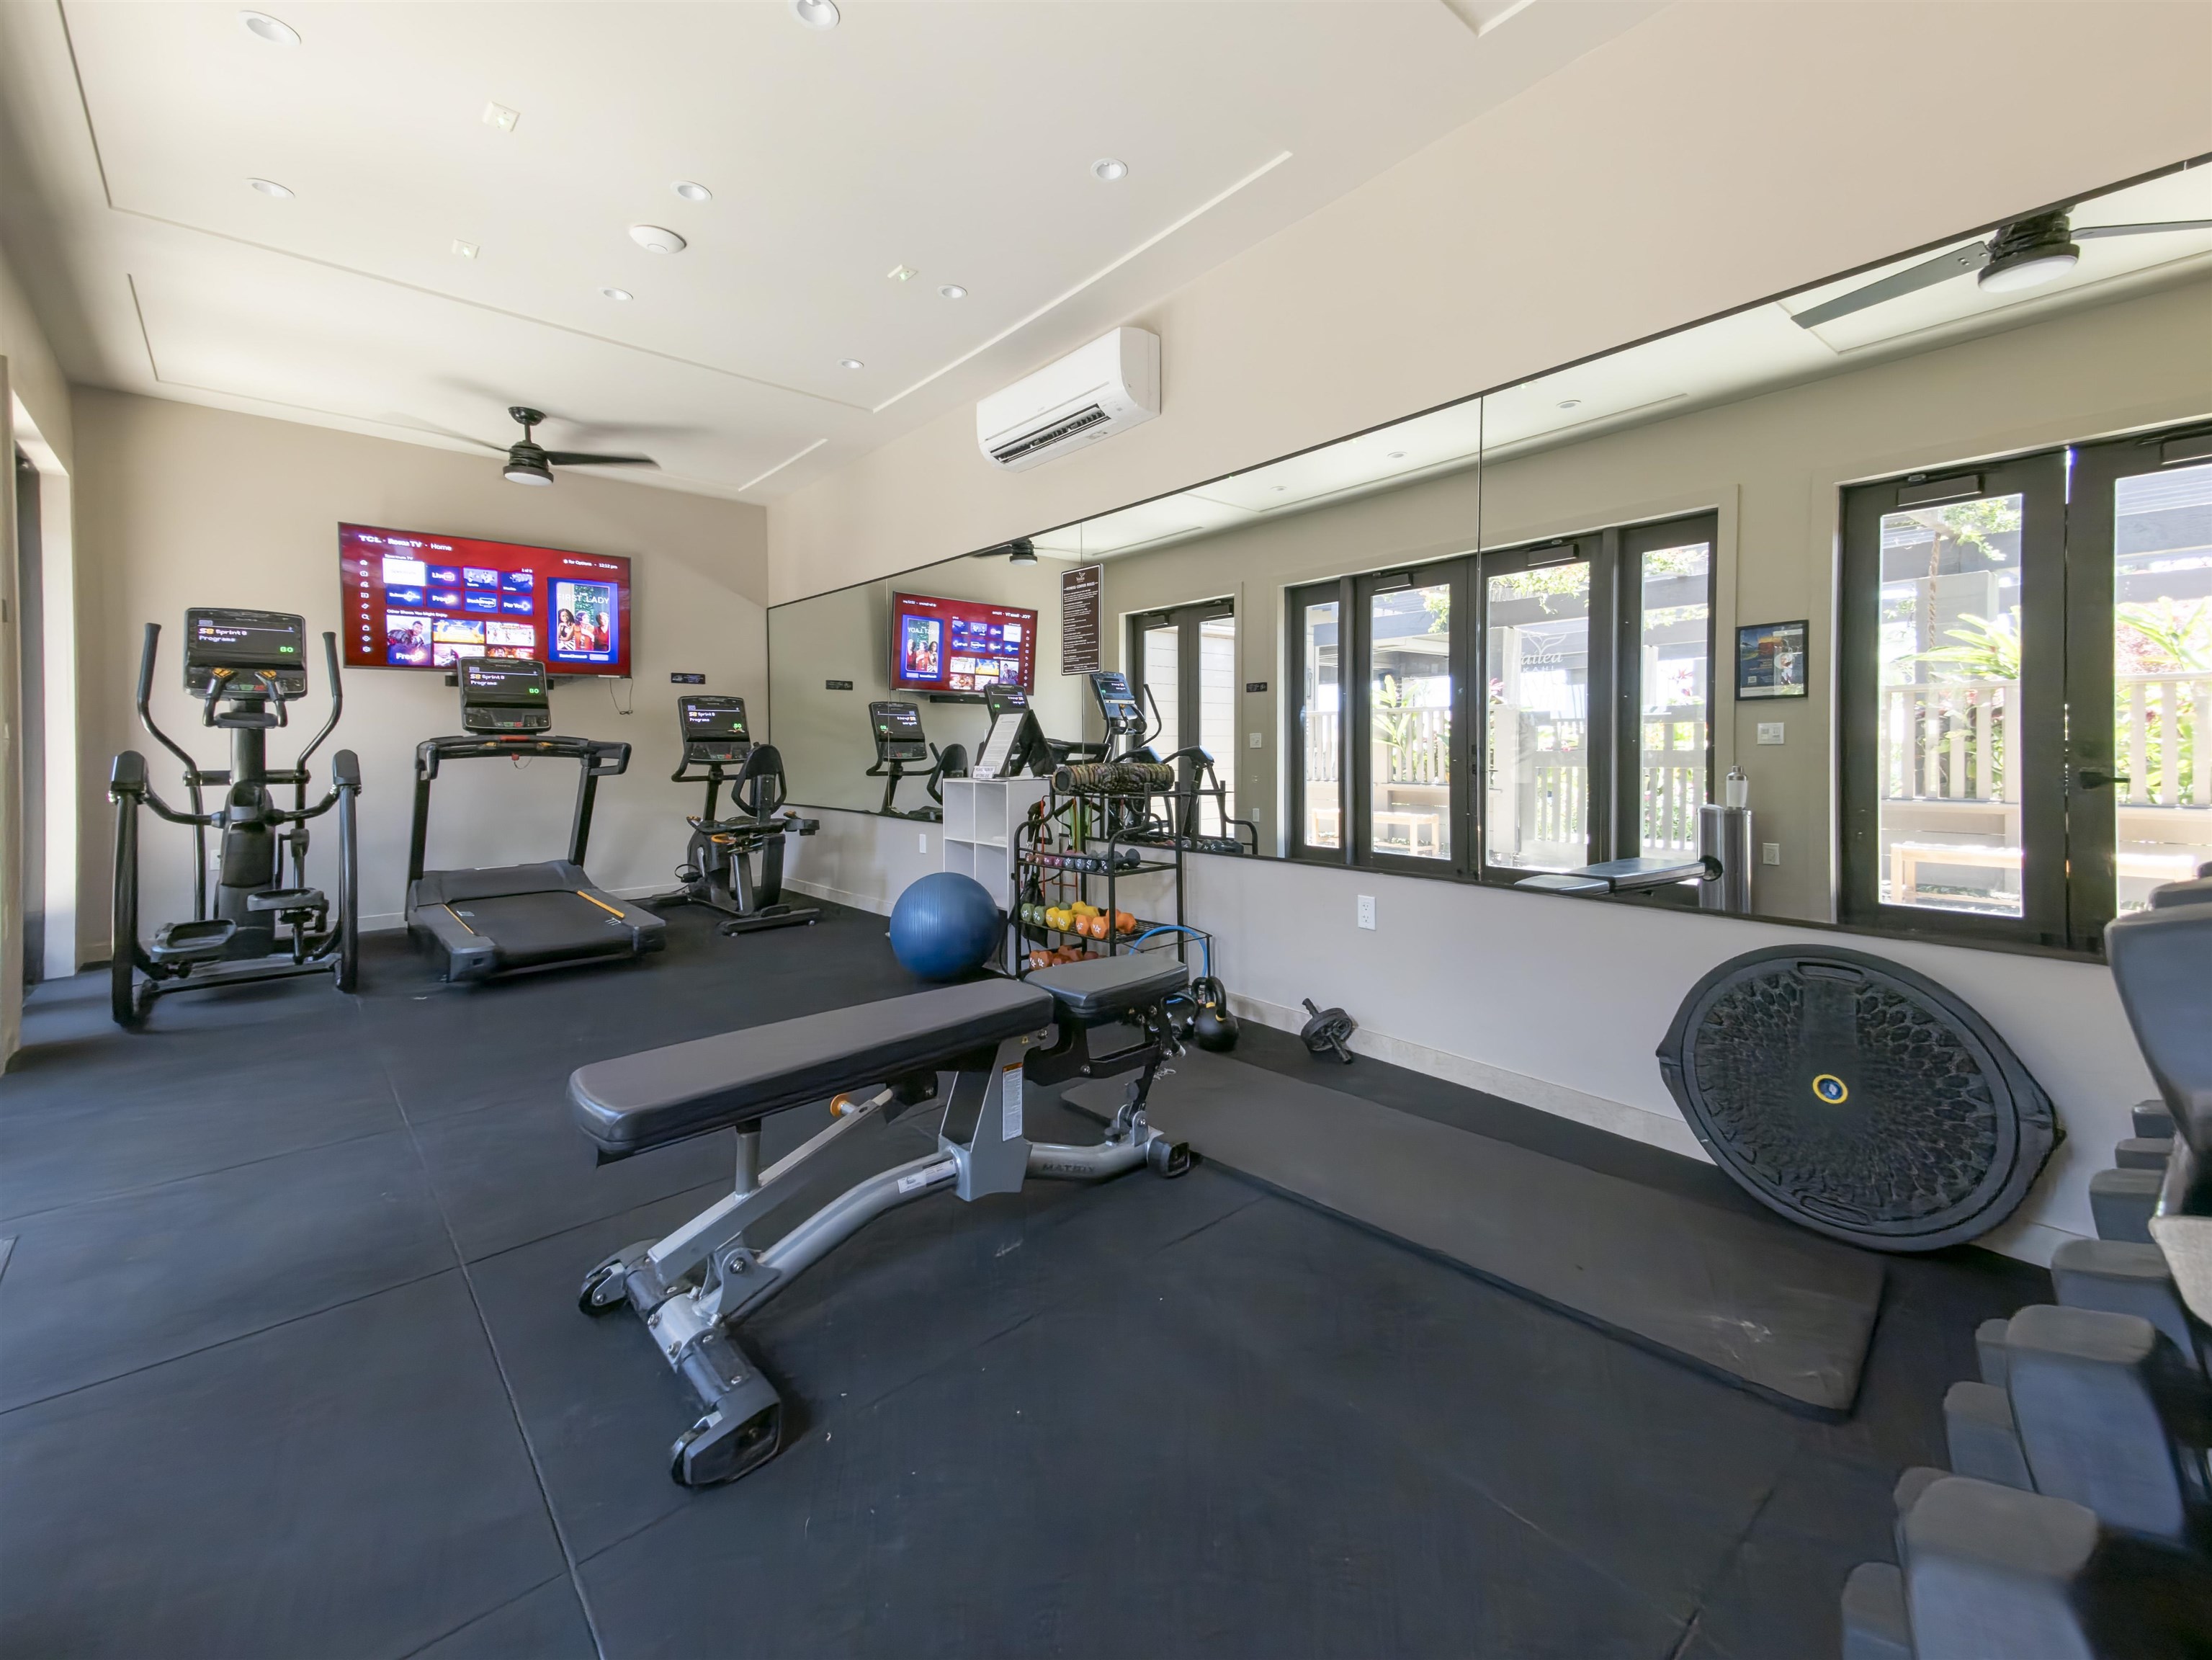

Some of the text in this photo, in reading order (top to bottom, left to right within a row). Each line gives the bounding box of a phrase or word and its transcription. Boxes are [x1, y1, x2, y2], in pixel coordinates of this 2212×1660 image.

[358, 535, 382, 543] TCL
[430, 543, 452, 551] Home
[557, 593, 609, 604] FIRST LADY
[1042, 1163, 1095, 1172] MATRIX
